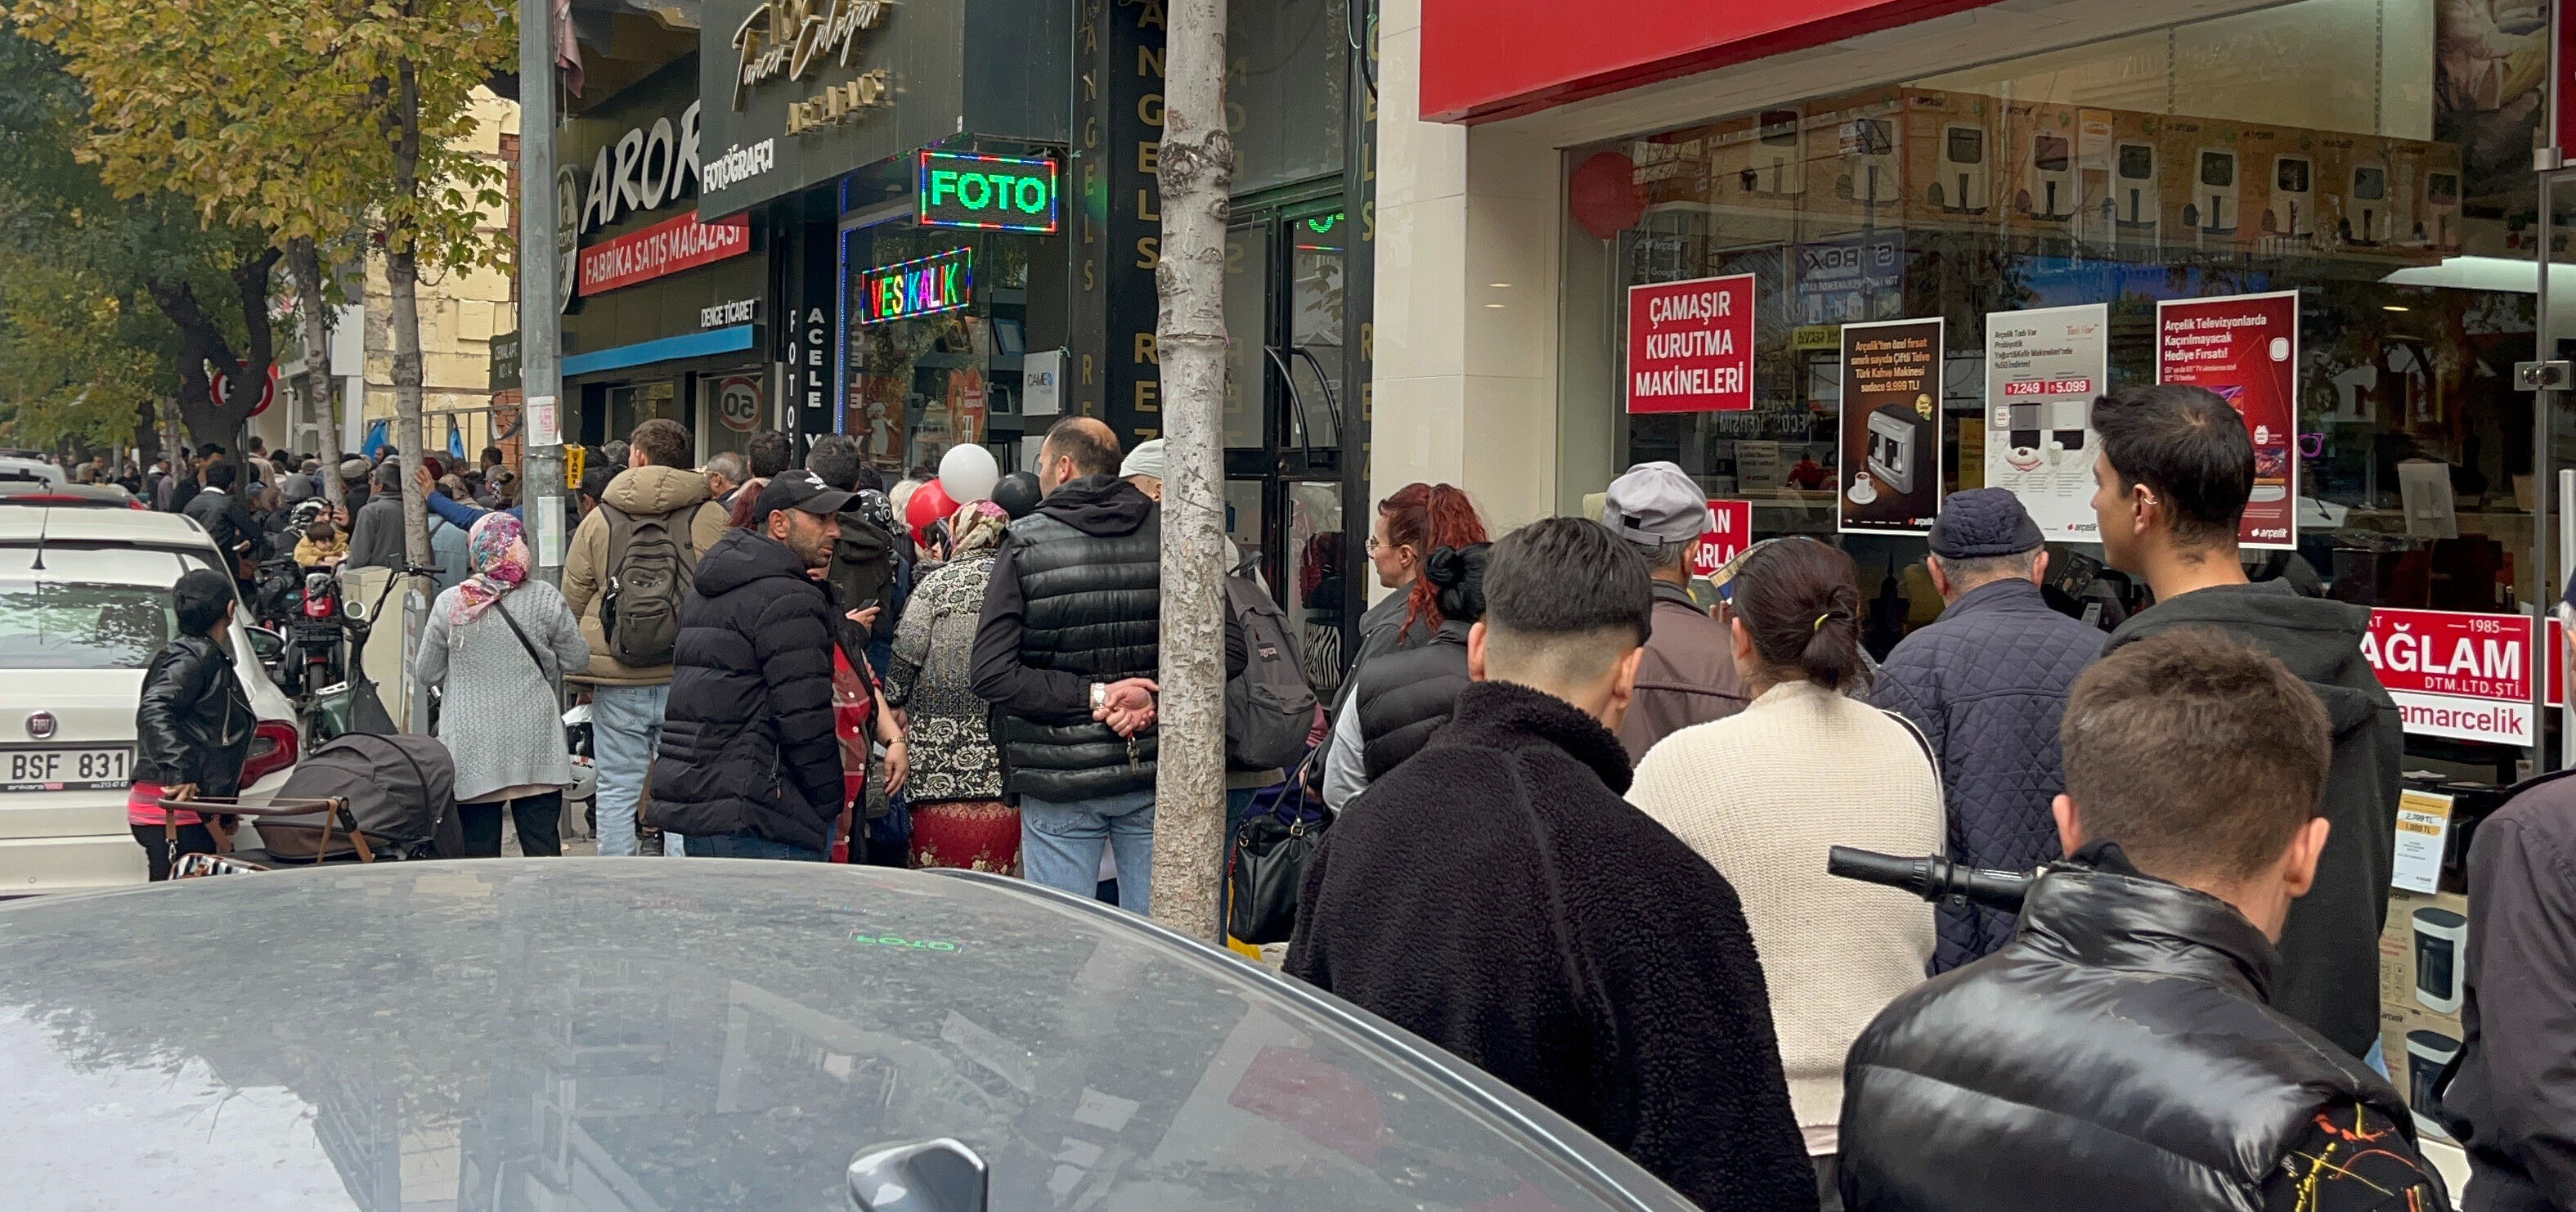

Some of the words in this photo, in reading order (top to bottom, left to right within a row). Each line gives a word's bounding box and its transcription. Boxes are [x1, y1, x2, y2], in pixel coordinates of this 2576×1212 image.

[1137, 0, 1166, 270] ANGELS
[931, 170, 1046, 213] FOTO
[586, 240, 632, 285] FABRİKA
[635, 231, 667, 273] SATIŞ
[871, 262, 958, 317] VESİKALIK
[725, 299, 754, 324] TİCARET
[1649, 290, 1730, 330] ÇAMAŞIR
[2165, 318, 2195, 333] Arçelik
[2196, 313, 2267, 330] Televizyonlarda
[1646, 329, 1734, 360] KURUTMA
[2165, 331, 2233, 348] Kaçırılmayacak
[808, 307, 825, 407] ACELE
[2165, 349, 2194, 362] Hediye
[2196, 347, 2228, 360] Fırsatı!
[1636, 361, 1744, 397] MAKİNELERİ
[1860, 381, 1885, 393] sadece
[1871, 367, 1892, 378] Kahve
[2260, 528, 2288, 540] arçelik
[2467, 618, 2501, 634] 1985
[2359, 622, 2520, 680] AĞLAM
[12, 753, 61, 780] BSF
[79, 752, 123, 779] 831
